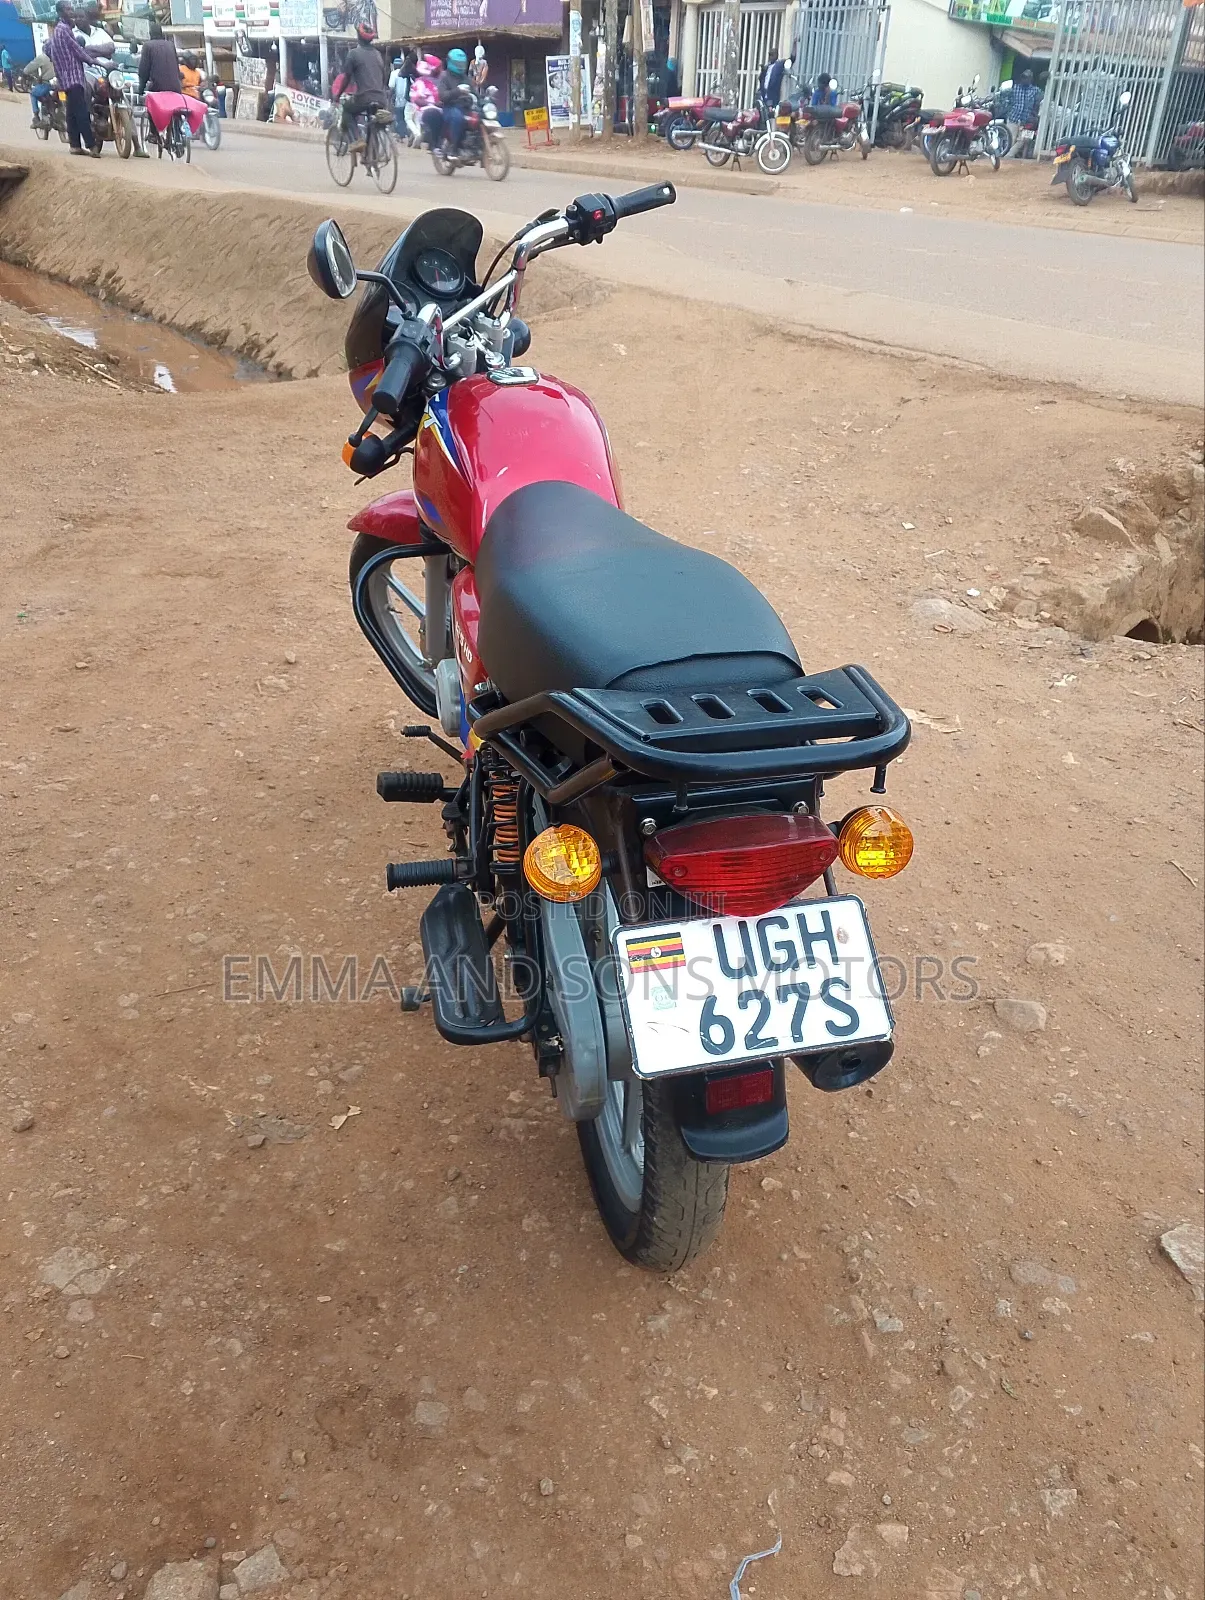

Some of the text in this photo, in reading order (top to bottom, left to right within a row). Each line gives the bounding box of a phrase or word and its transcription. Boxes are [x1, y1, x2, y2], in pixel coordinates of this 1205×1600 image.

[291, 92, 321, 108] JOYCE
[713, 910, 839, 979] UGH
[699, 977, 860, 1055] 627S
